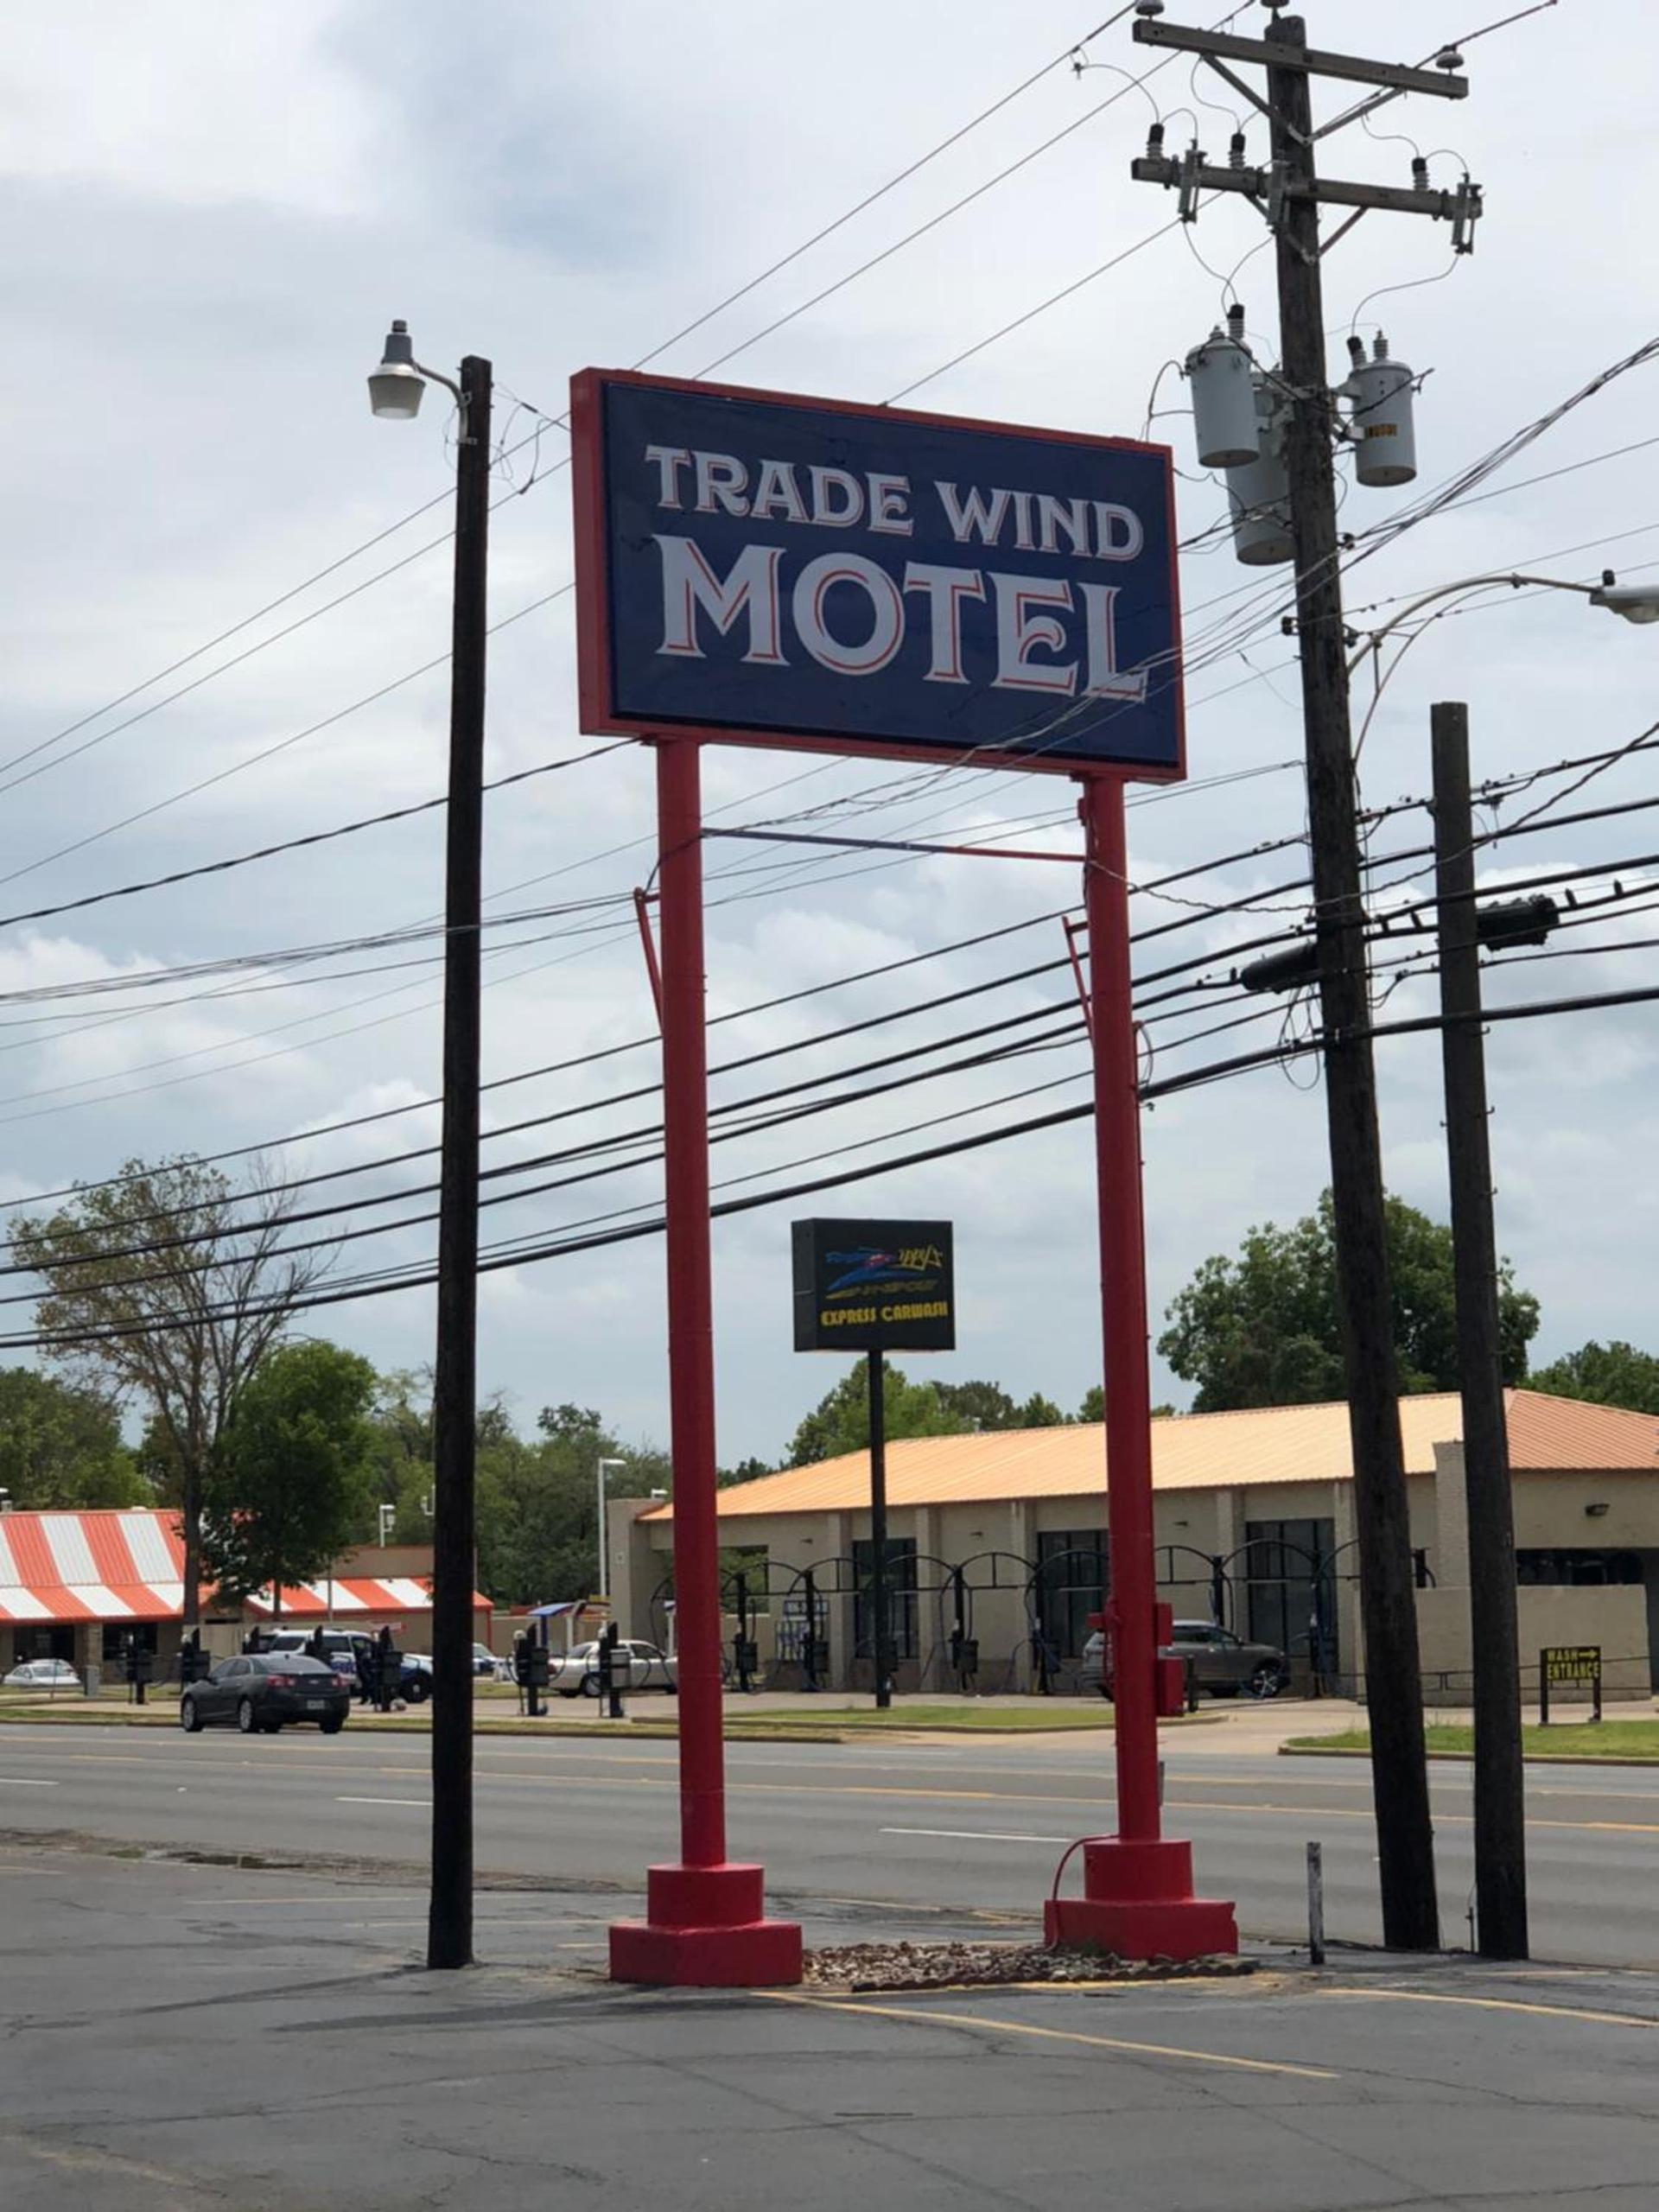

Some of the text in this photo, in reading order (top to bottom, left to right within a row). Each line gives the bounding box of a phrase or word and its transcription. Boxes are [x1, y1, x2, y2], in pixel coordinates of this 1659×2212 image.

[645, 445, 1143, 561] TRADE WIND
[652, 534, 1147, 702] MOTEL
[822, 1301, 948, 1326] EXPRESS CARWASH
[1548, 1649, 1578, 1661] WASH
[1548, 1662, 1599, 1679] ENTRANCE
